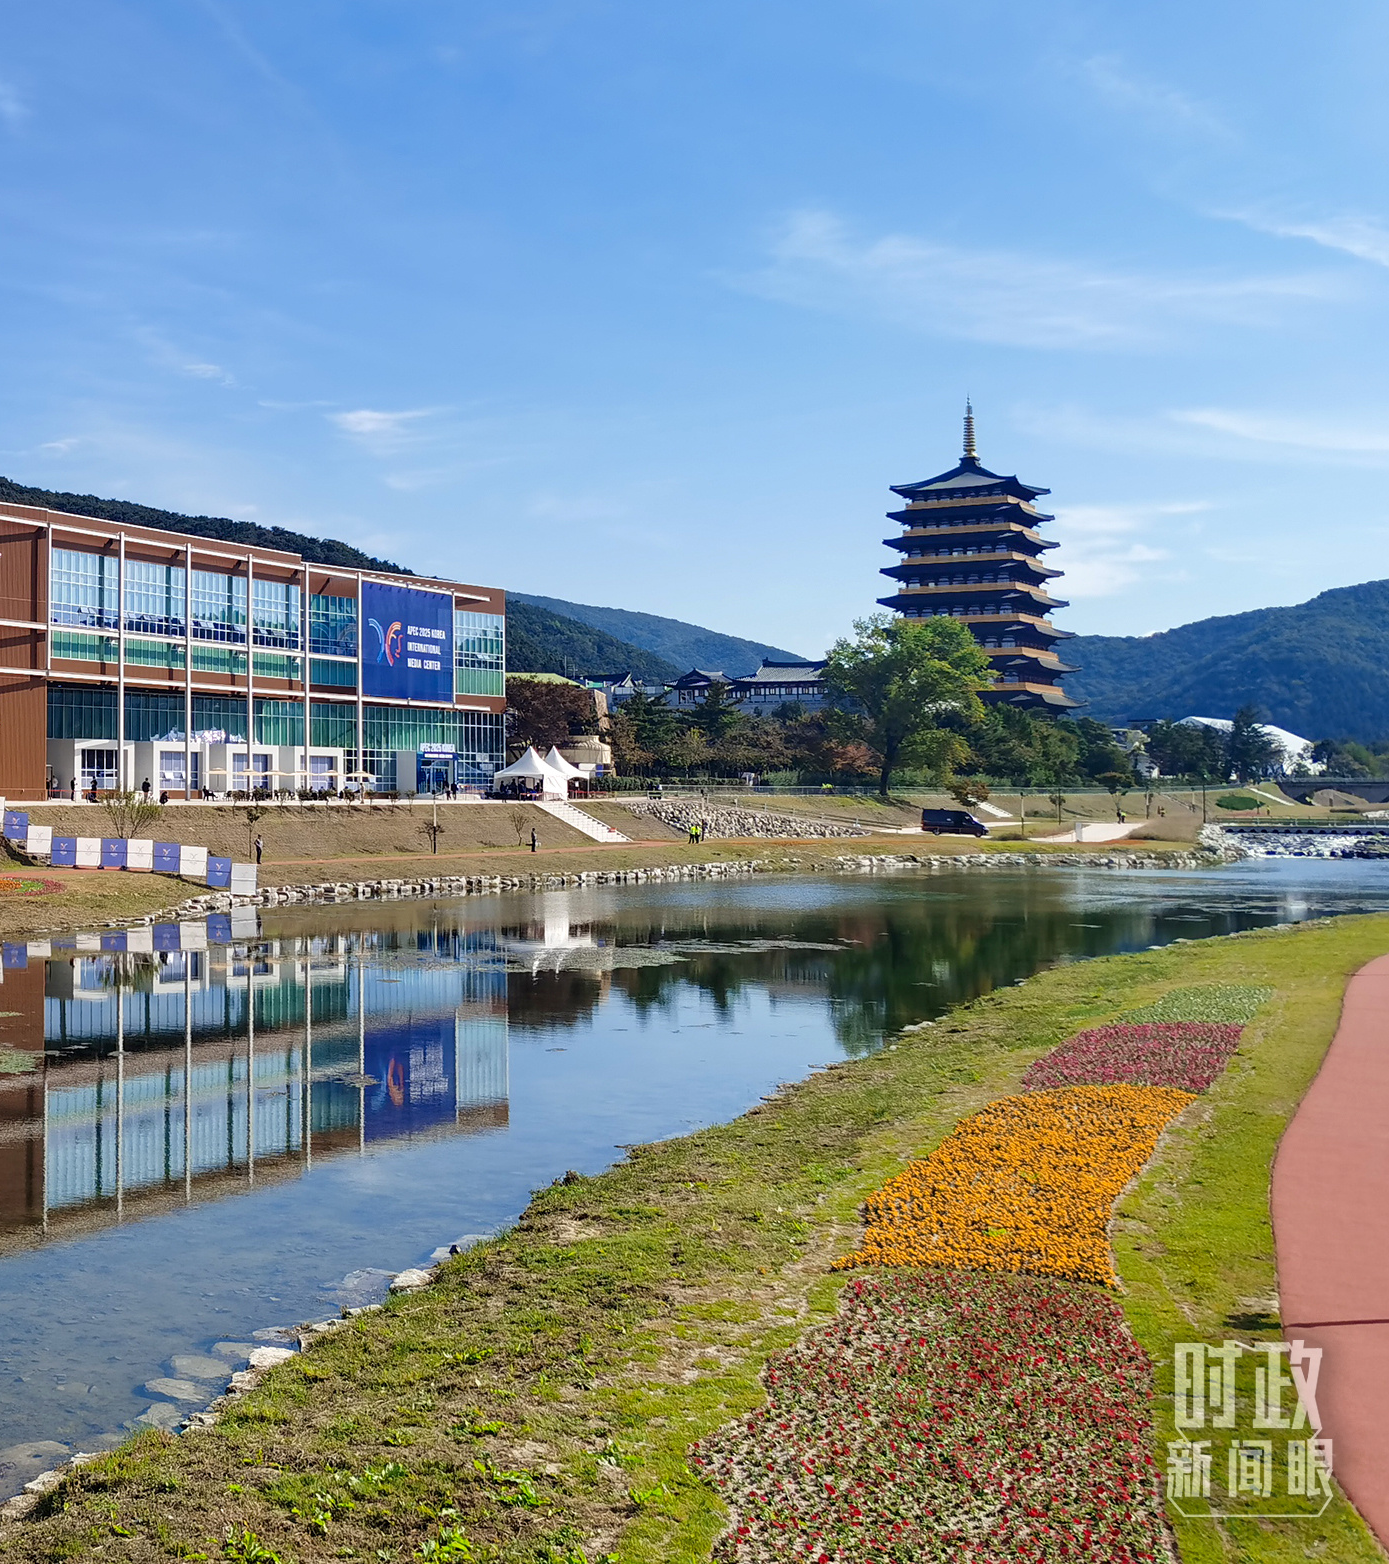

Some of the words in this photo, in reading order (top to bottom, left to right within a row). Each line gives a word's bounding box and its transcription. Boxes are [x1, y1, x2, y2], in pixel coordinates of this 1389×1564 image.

[407, 625, 419, 636] APEC
[419, 627, 431, 638] 2025
[431, 629, 446, 640] KOREA
[407, 641, 441, 655] INTERNATIONAL
[407, 657, 422, 668] MEDIA
[423, 659, 441, 671] CENTER
